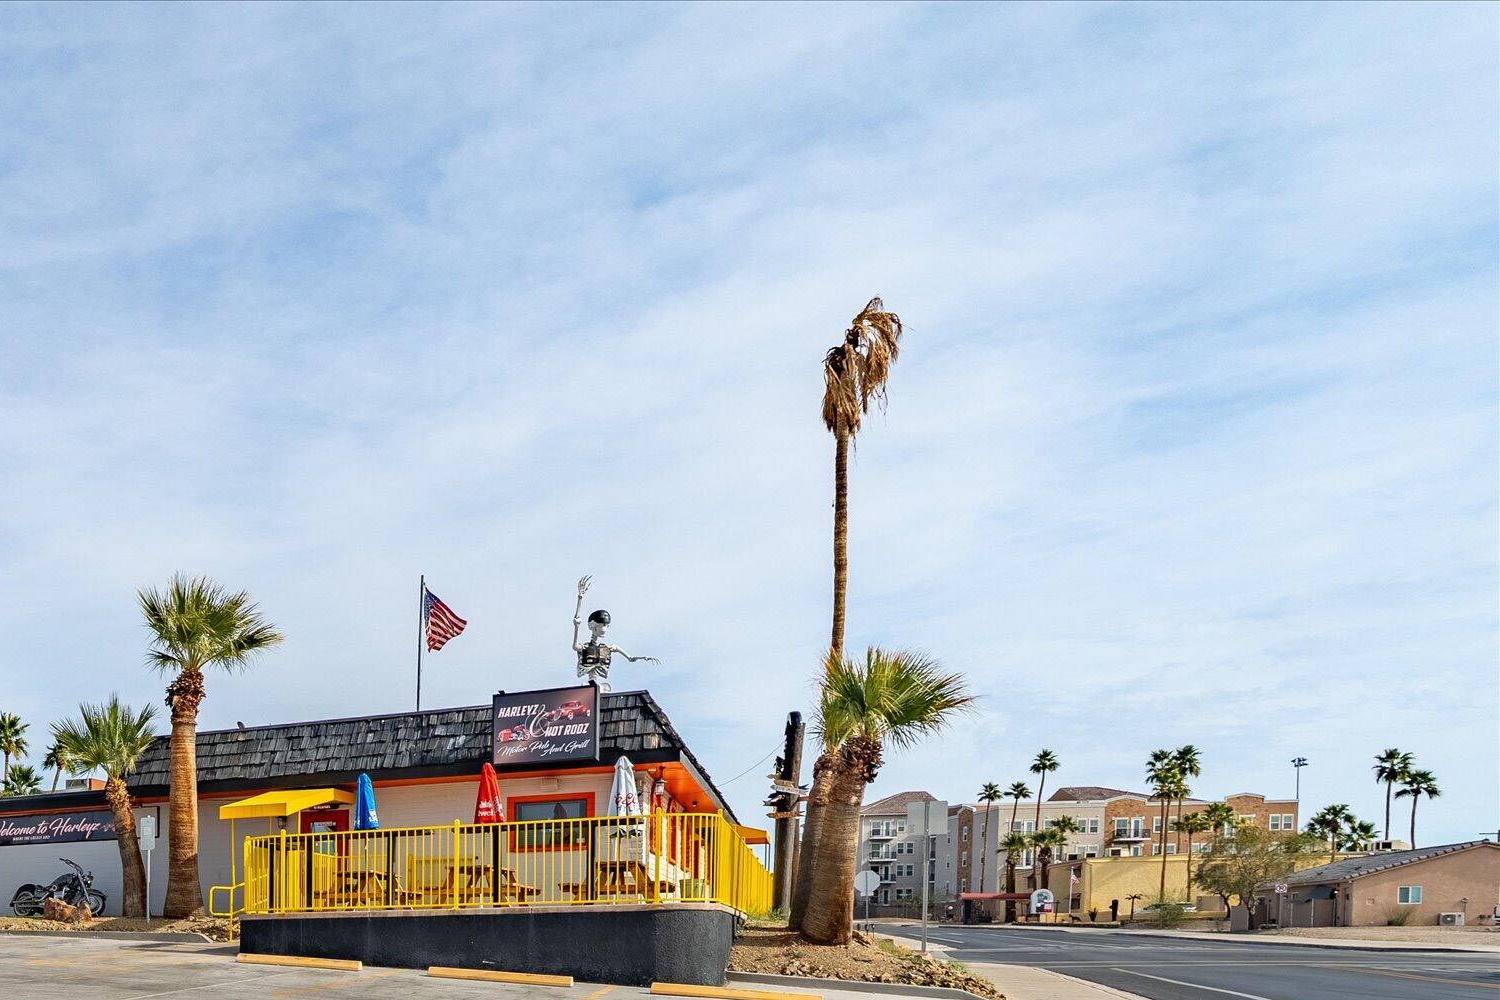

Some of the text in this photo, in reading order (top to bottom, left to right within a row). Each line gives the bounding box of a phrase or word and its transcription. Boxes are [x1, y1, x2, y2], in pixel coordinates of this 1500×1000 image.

[498, 704, 540, 718] HARLEYZ
[544, 723, 589, 737] HOT RODZ
[497, 740, 550, 757] Motor Pub
[540, 739, 590, 757] And Grill
[36, 820, 49, 834] to
[50, 817, 100, 839] Harleyz
